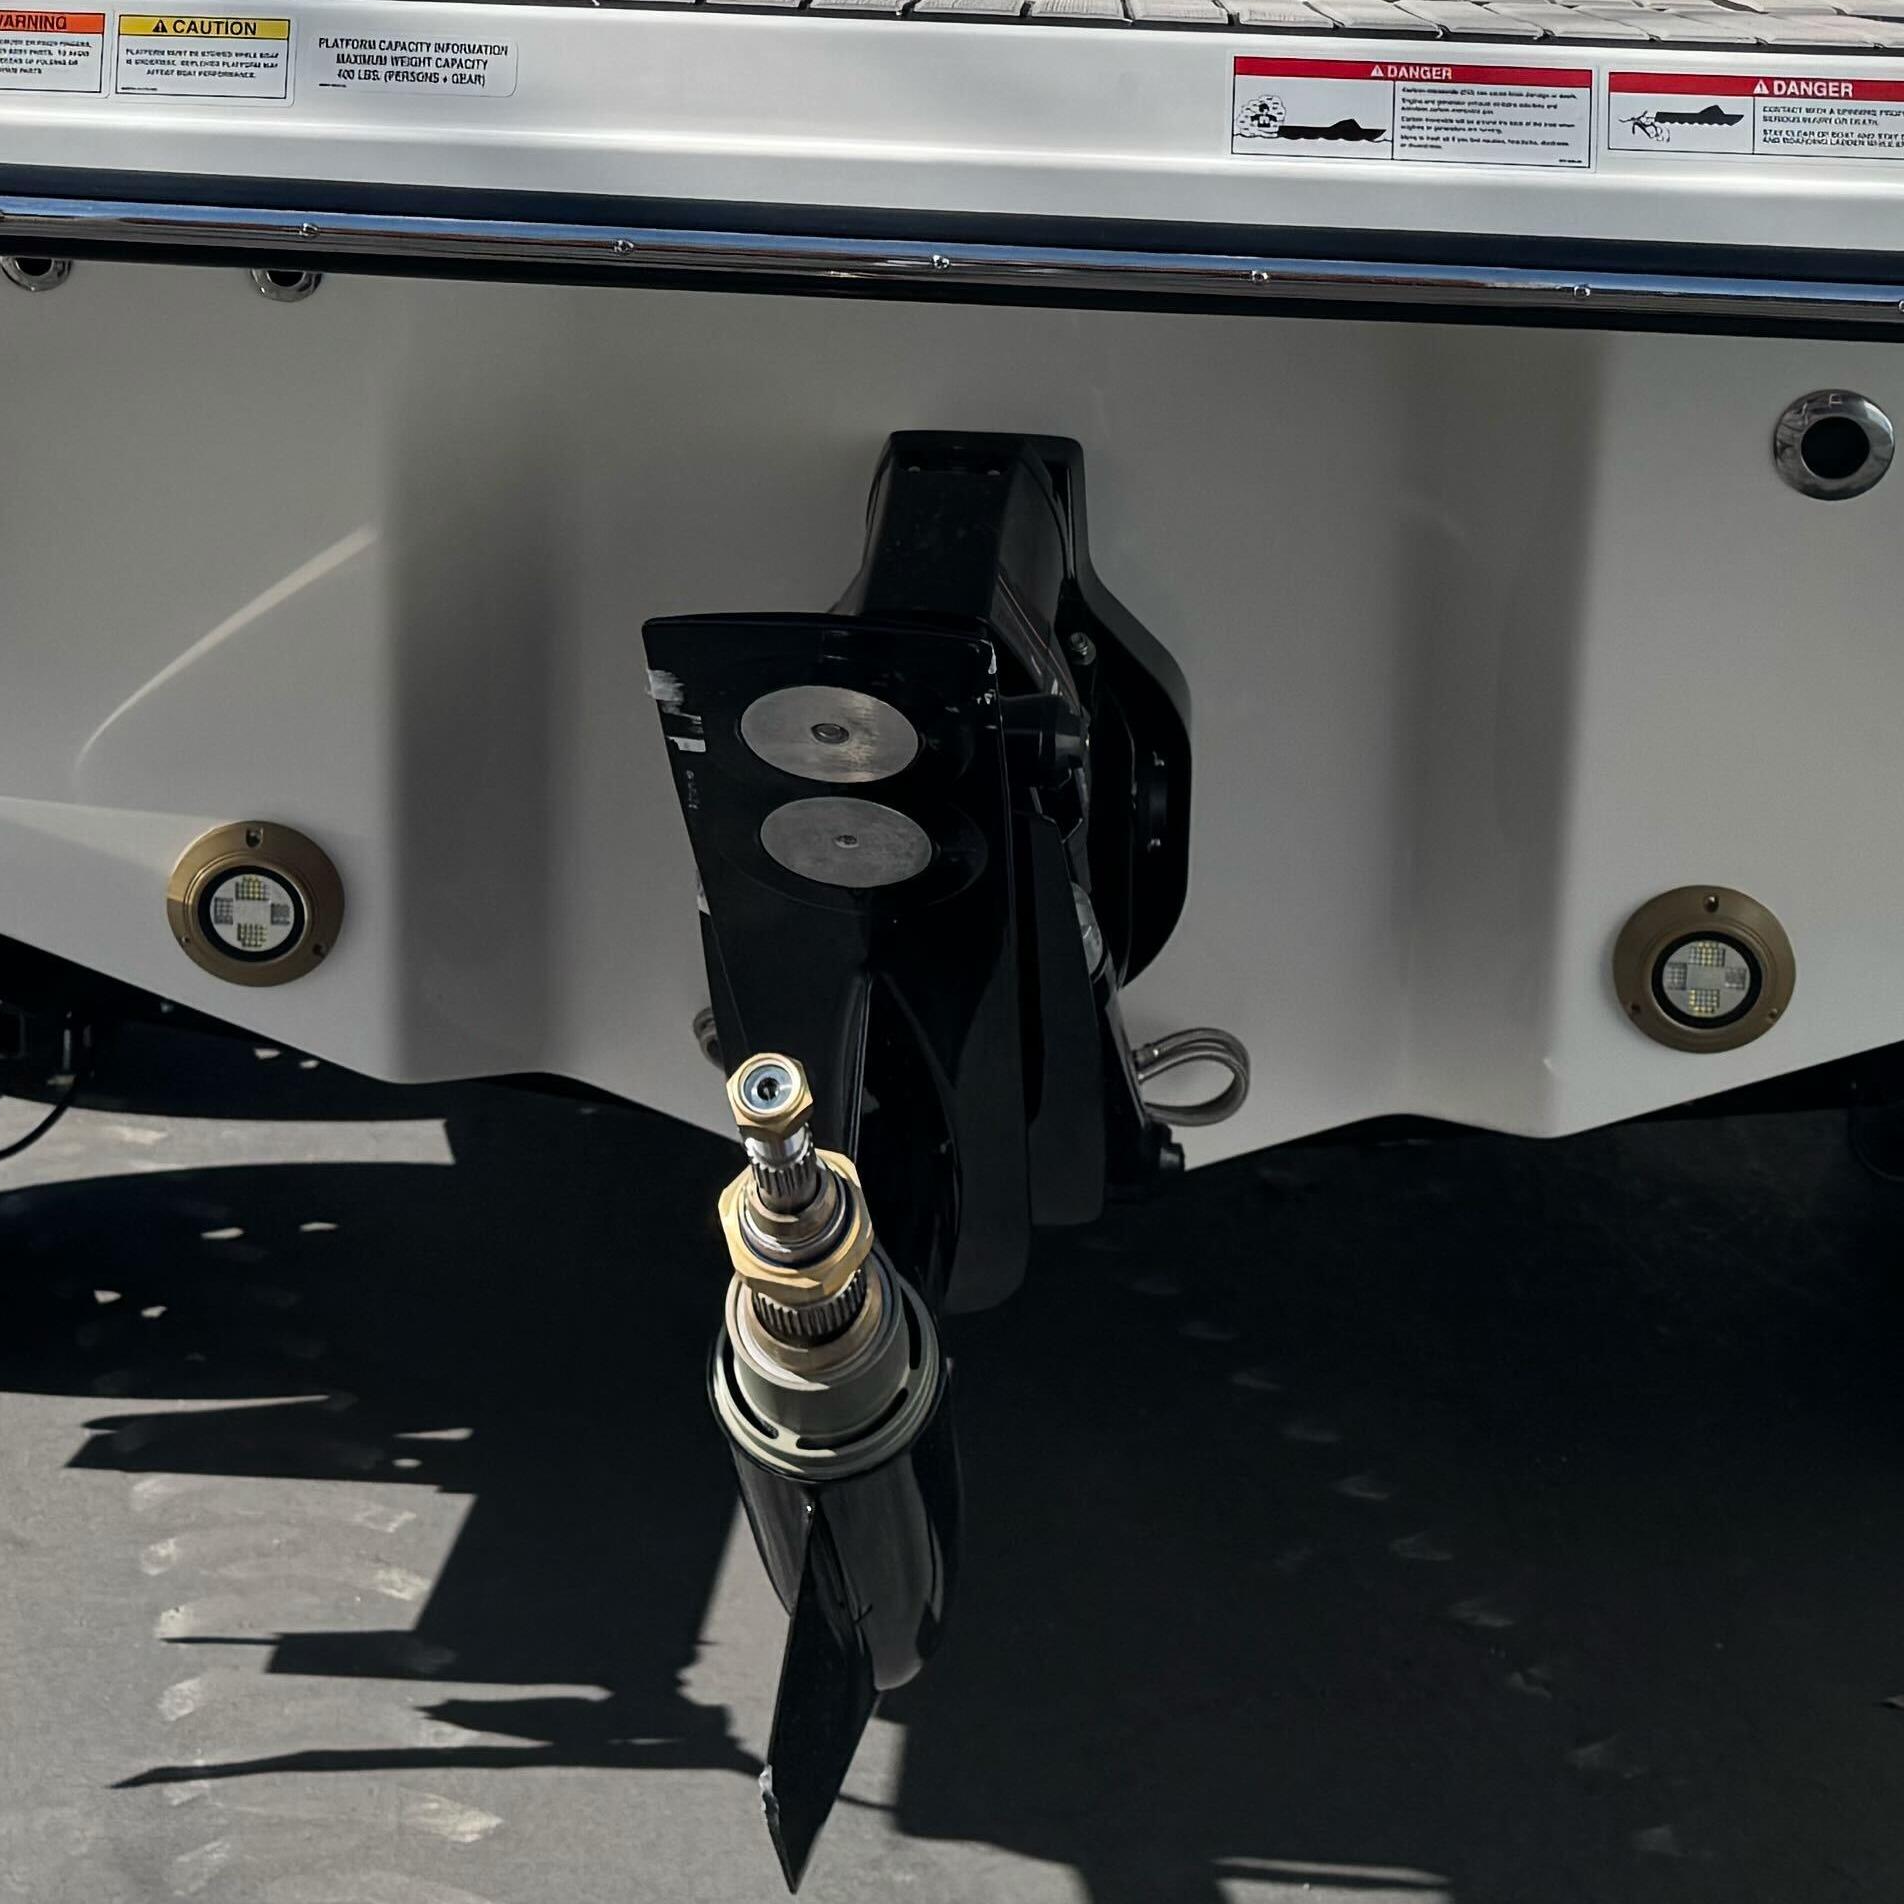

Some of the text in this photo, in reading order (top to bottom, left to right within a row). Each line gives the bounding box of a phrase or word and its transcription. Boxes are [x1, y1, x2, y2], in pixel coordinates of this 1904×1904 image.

[173, 19, 257, 35] CAUTION
[319, 38, 508, 55] PLATFORM CAPACITY INFORMATION
[336, 54, 488, 70] MAXIMUM WEIGHT CAPACITY
[1387, 65, 1452, 80] DANGER
[1773, 81, 1853, 97] DANGER
